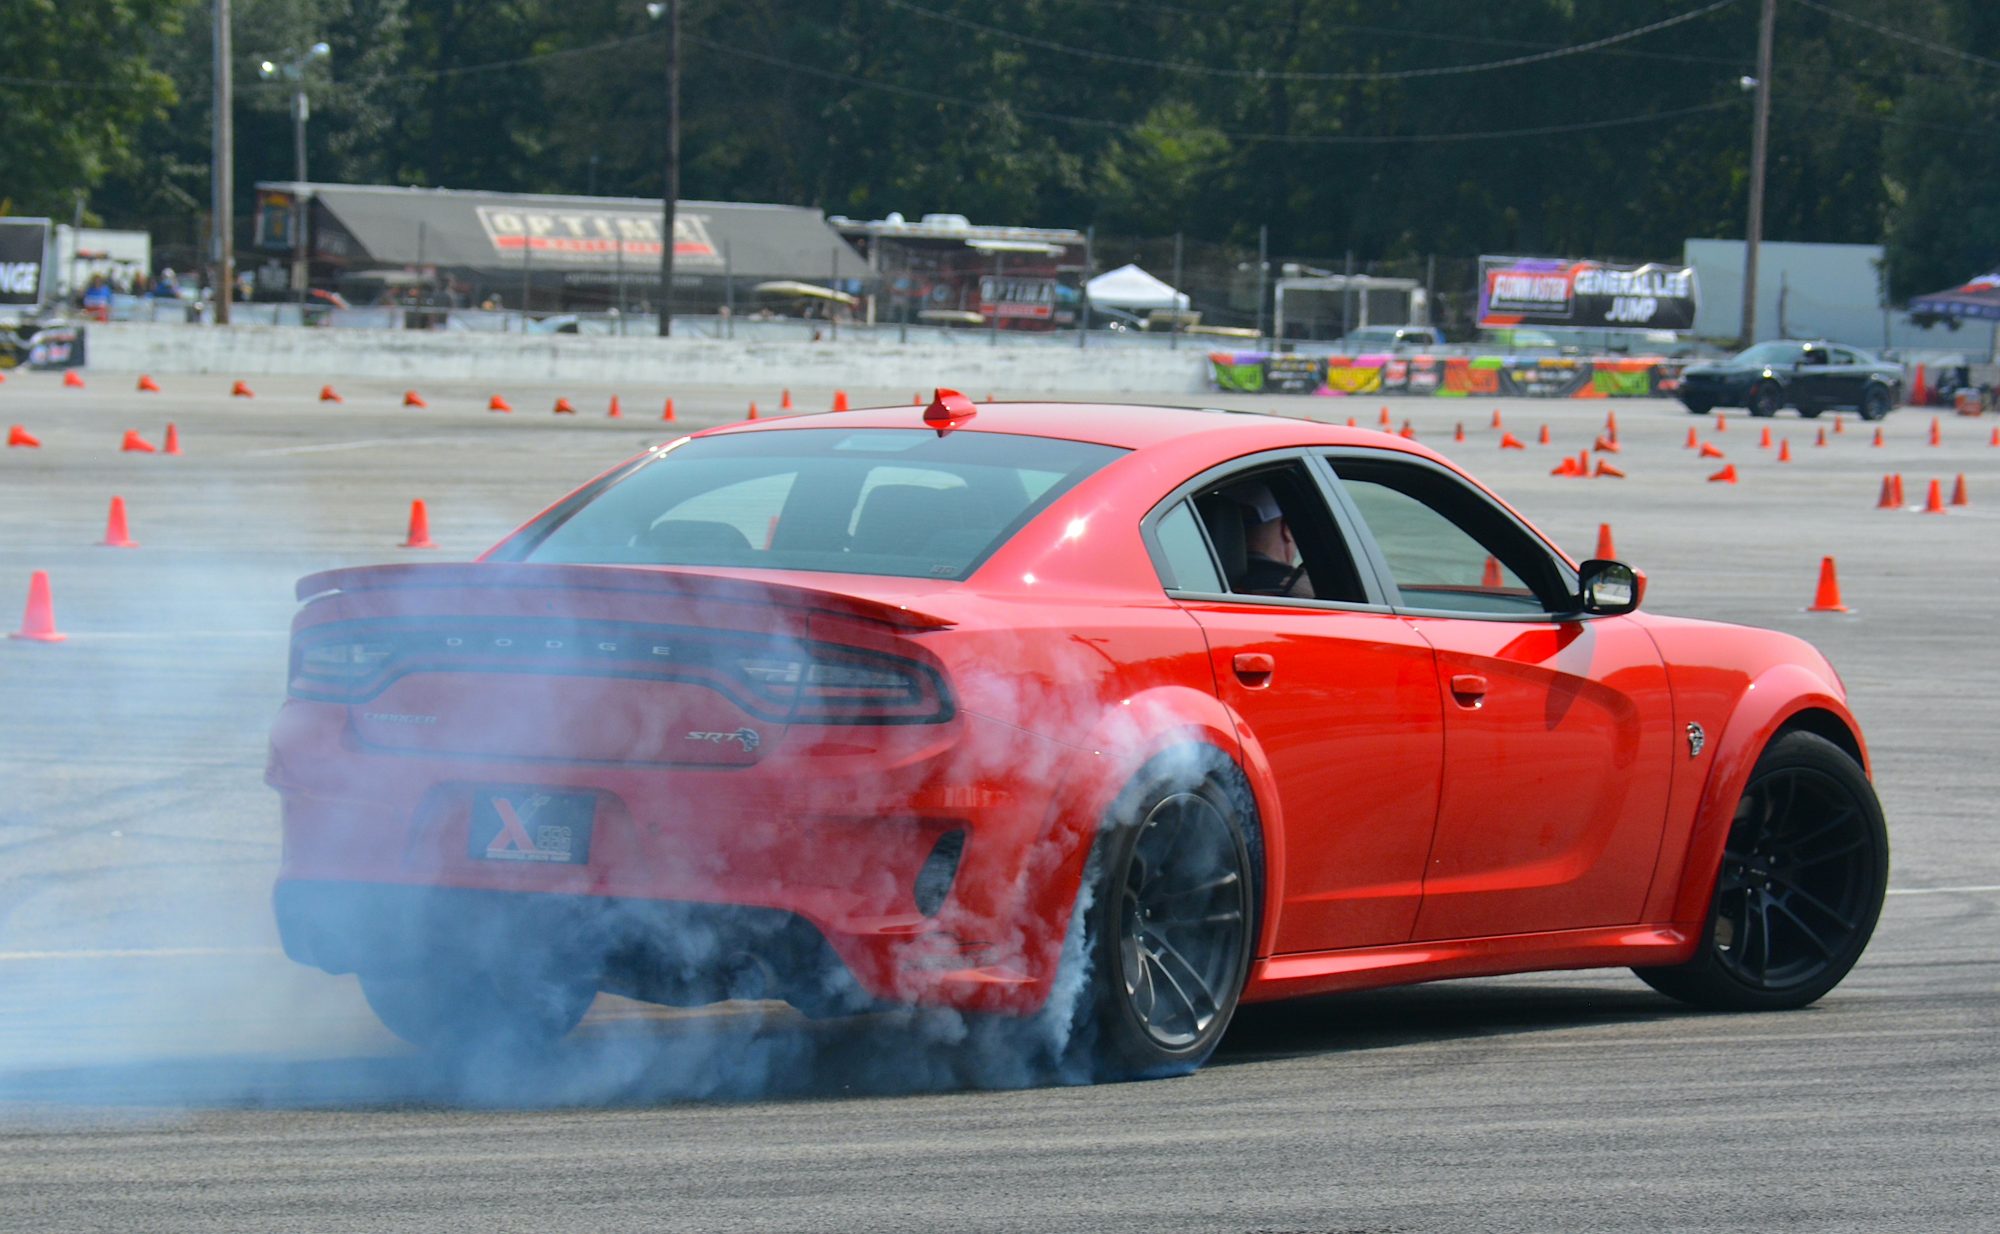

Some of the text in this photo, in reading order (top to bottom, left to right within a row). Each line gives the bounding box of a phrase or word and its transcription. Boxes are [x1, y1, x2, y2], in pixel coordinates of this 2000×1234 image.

[492, 213, 699, 242] OPTIMA
[1574, 269, 1690, 297] GENERAL LEE
[1605, 296, 1658, 323] JUMP
[446, 637, 671, 656] DODGE
[684, 731, 742, 744] SRT
